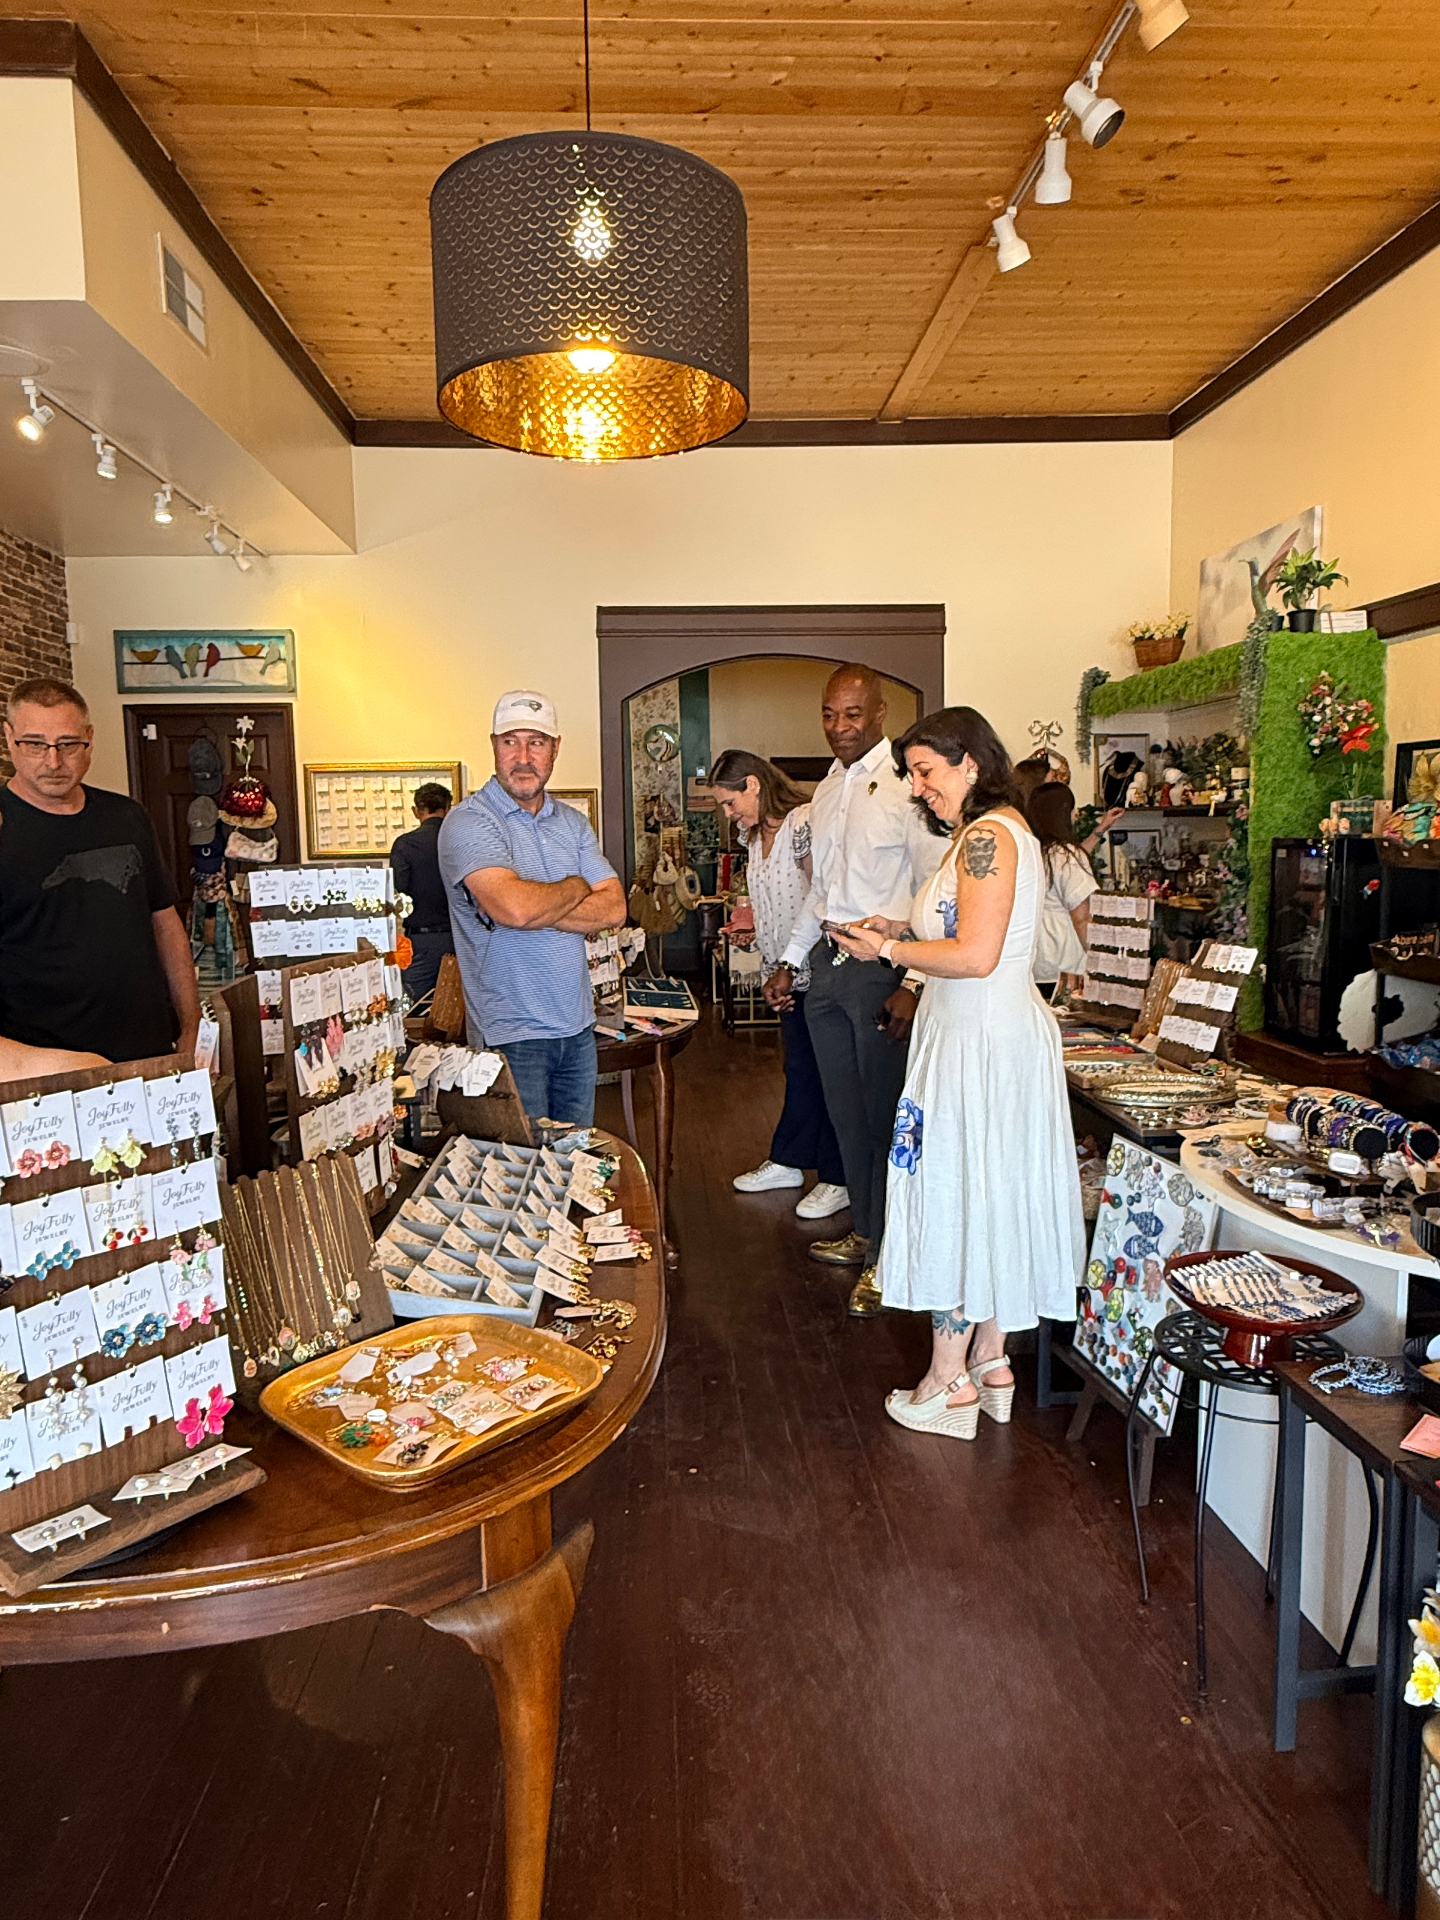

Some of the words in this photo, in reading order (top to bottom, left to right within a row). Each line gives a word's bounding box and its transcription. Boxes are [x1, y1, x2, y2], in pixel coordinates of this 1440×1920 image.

[87, 1101, 136, 1127] JoyFully
[157, 1091, 202, 1115] JoyFully
[167, 1107, 196, 1118] JEWELRY
[11, 1114, 65, 1141] JoyFully
[98, 1116, 129, 1130] JEWELRY
[24, 1131, 58, 1145] JEWELRY
[162, 1180, 207, 1206] JoyFully
[93, 1198, 141, 1222] JoyFully
[22, 1213, 76, 1241] JoyFully
[106, 1287, 153, 1319] JoyFully
[117, 1303, 147, 1320] JEWELRY
[32, 1309, 82, 1341] JoyFully
[44, 1325, 76, 1343] JEWELRY
[178, 1359, 220, 1389] JoyFully
[187, 1374, 215, 1391] JEWELRY
[112, 1380, 158, 1412] JoyFully
[122, 1396, 152, 1414] JEWELRY
